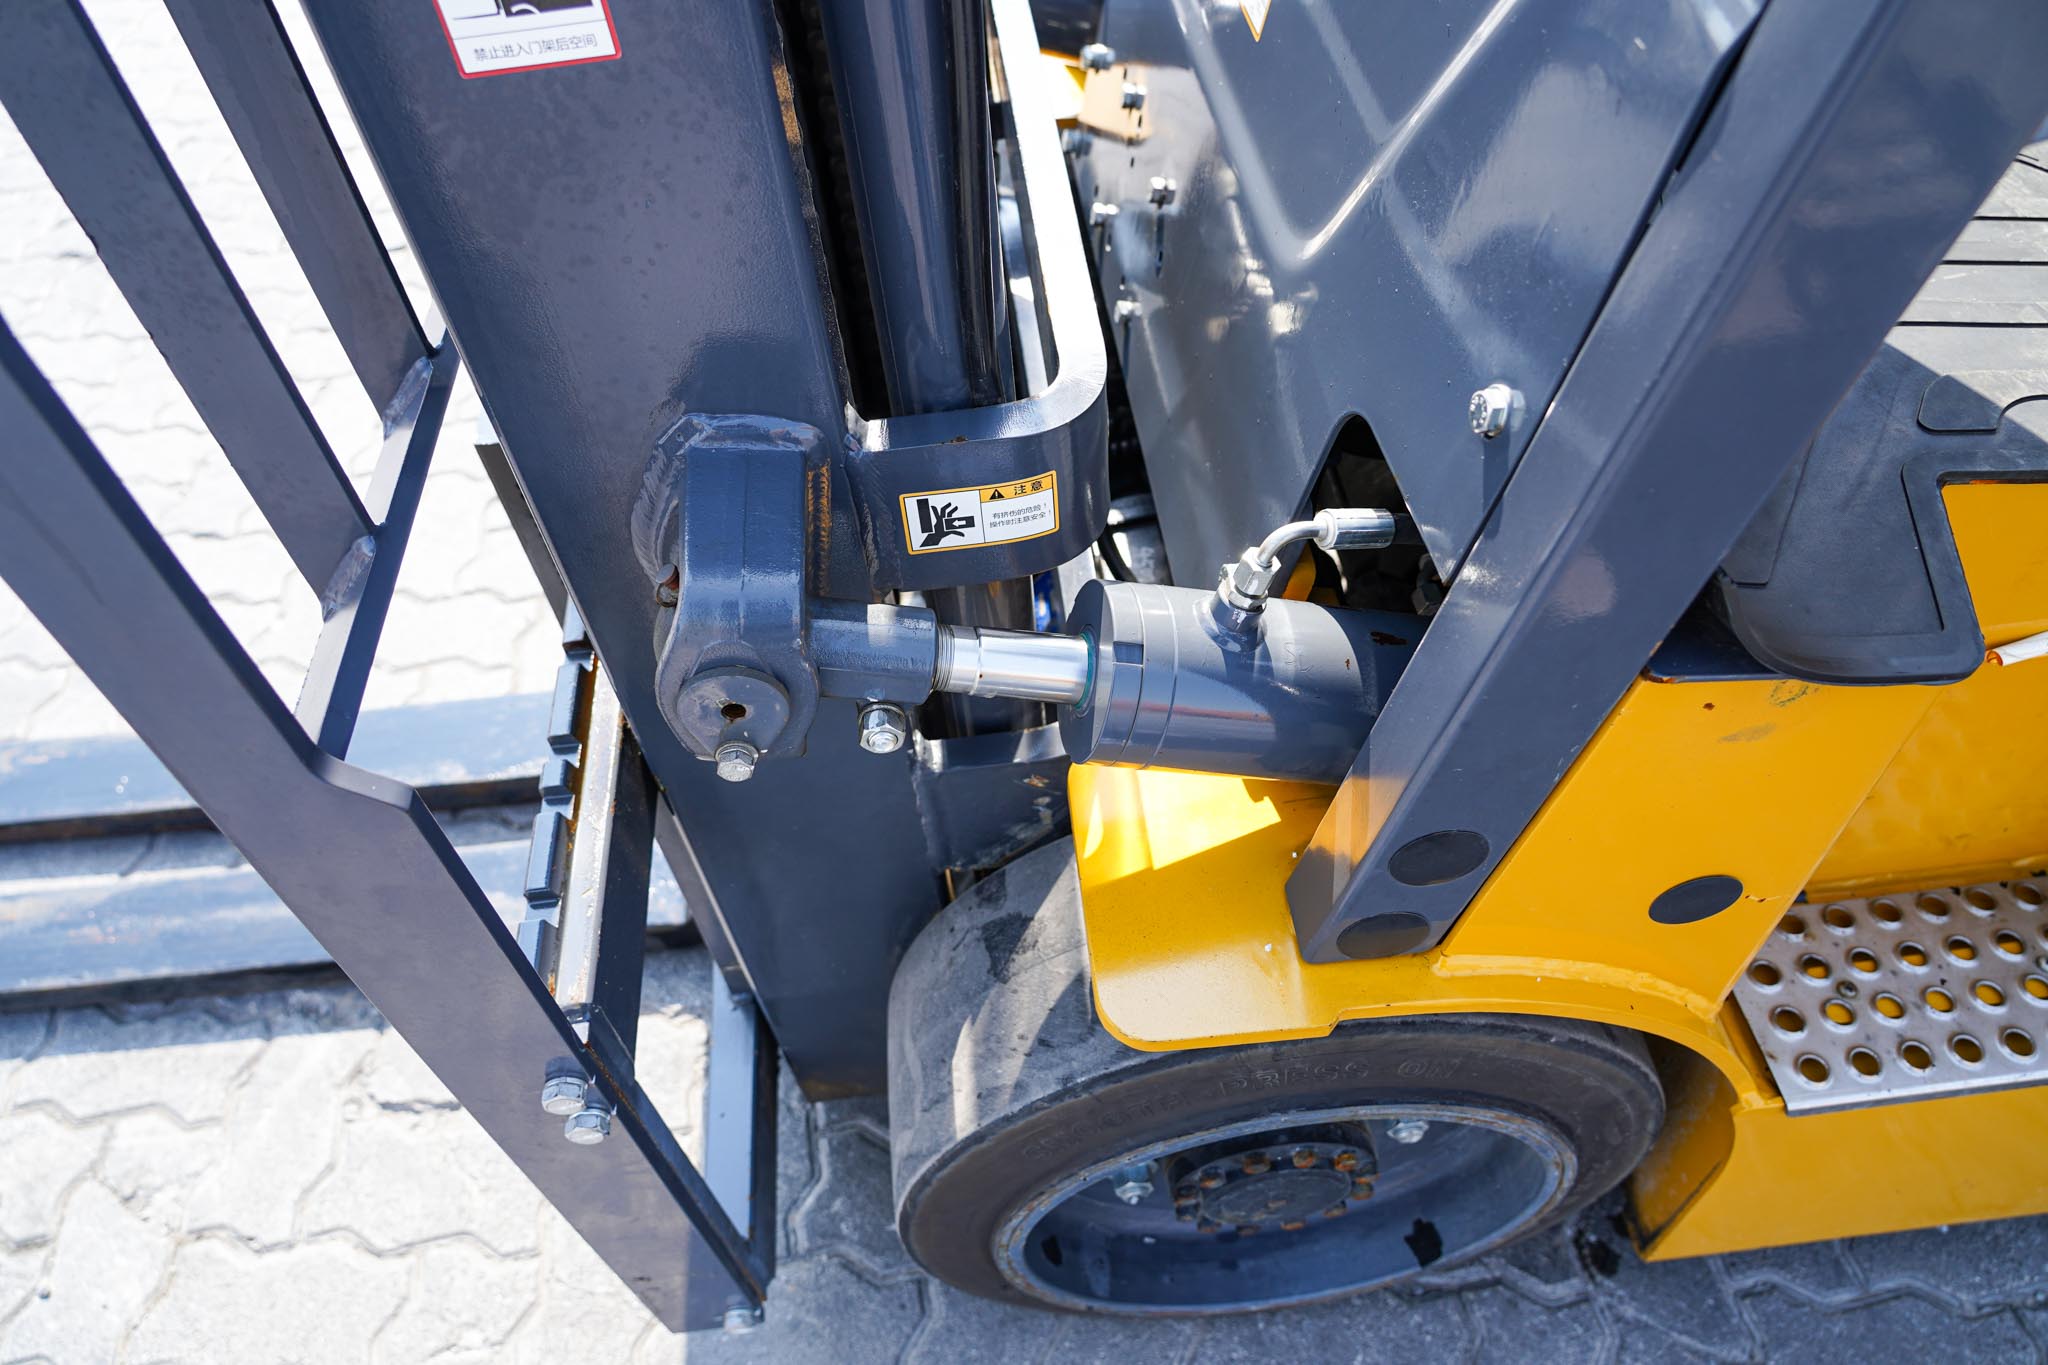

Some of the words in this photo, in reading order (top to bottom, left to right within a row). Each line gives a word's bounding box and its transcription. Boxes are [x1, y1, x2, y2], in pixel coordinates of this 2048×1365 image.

[474, 33, 598, 61] 禁止进入门架后空间
[1014, 480, 1044, 496] 注意
[1218, 1062, 1369, 1096] PRESS
[1396, 1058, 1461, 1080] ON
